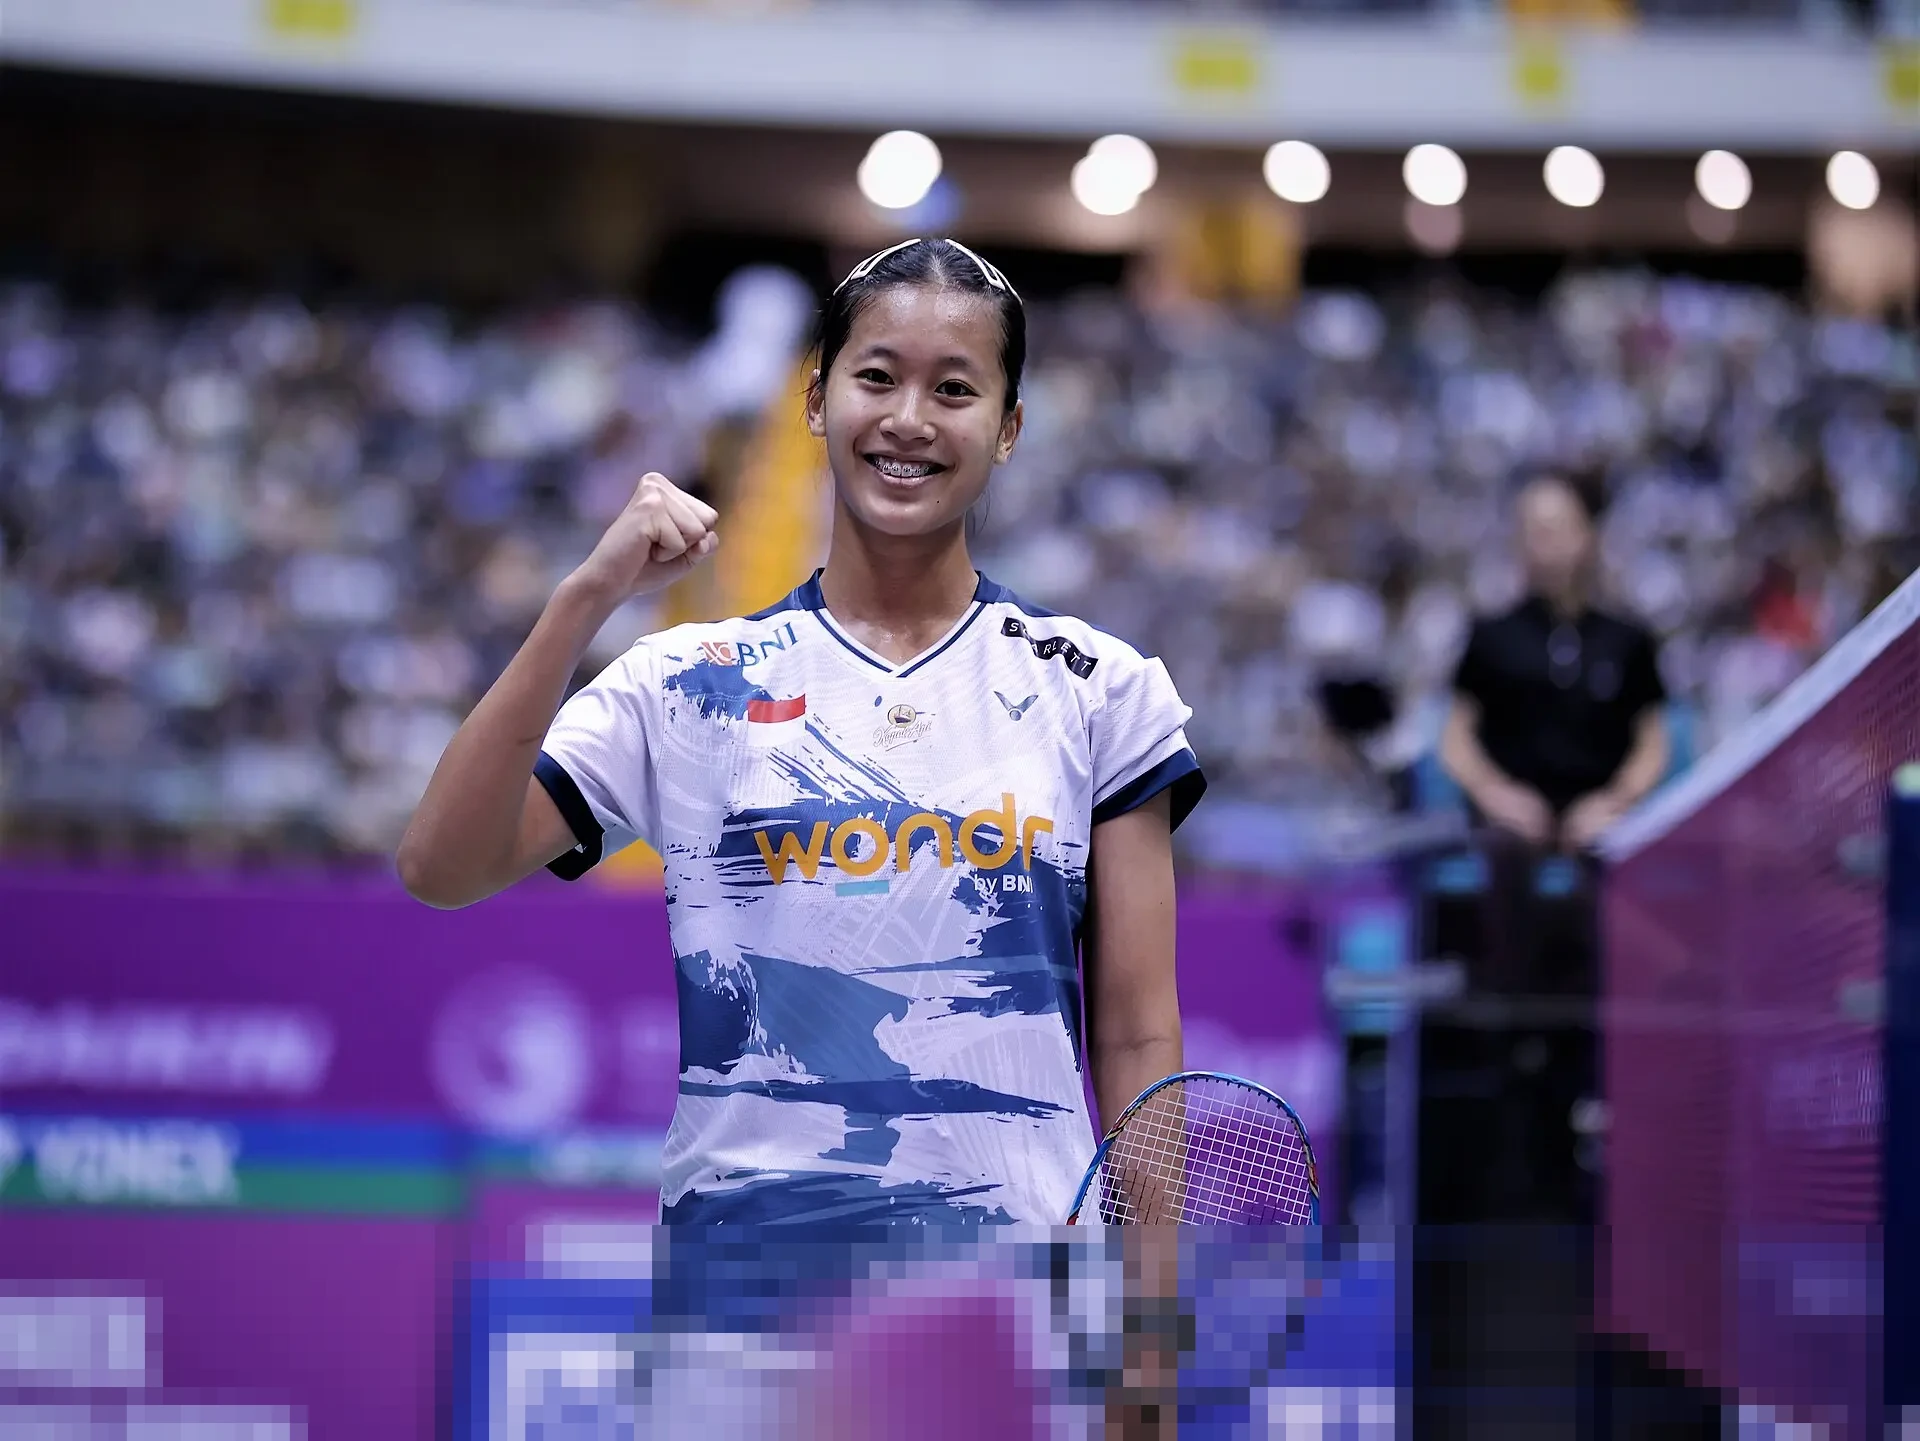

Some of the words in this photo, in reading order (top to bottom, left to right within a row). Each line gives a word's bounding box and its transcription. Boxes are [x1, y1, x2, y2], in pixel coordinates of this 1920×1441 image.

[736, 622, 798, 667] BNI
[754, 793, 1053, 886] wondr
[974, 873, 998, 895] by
[1002, 874, 1034, 894] BNI
